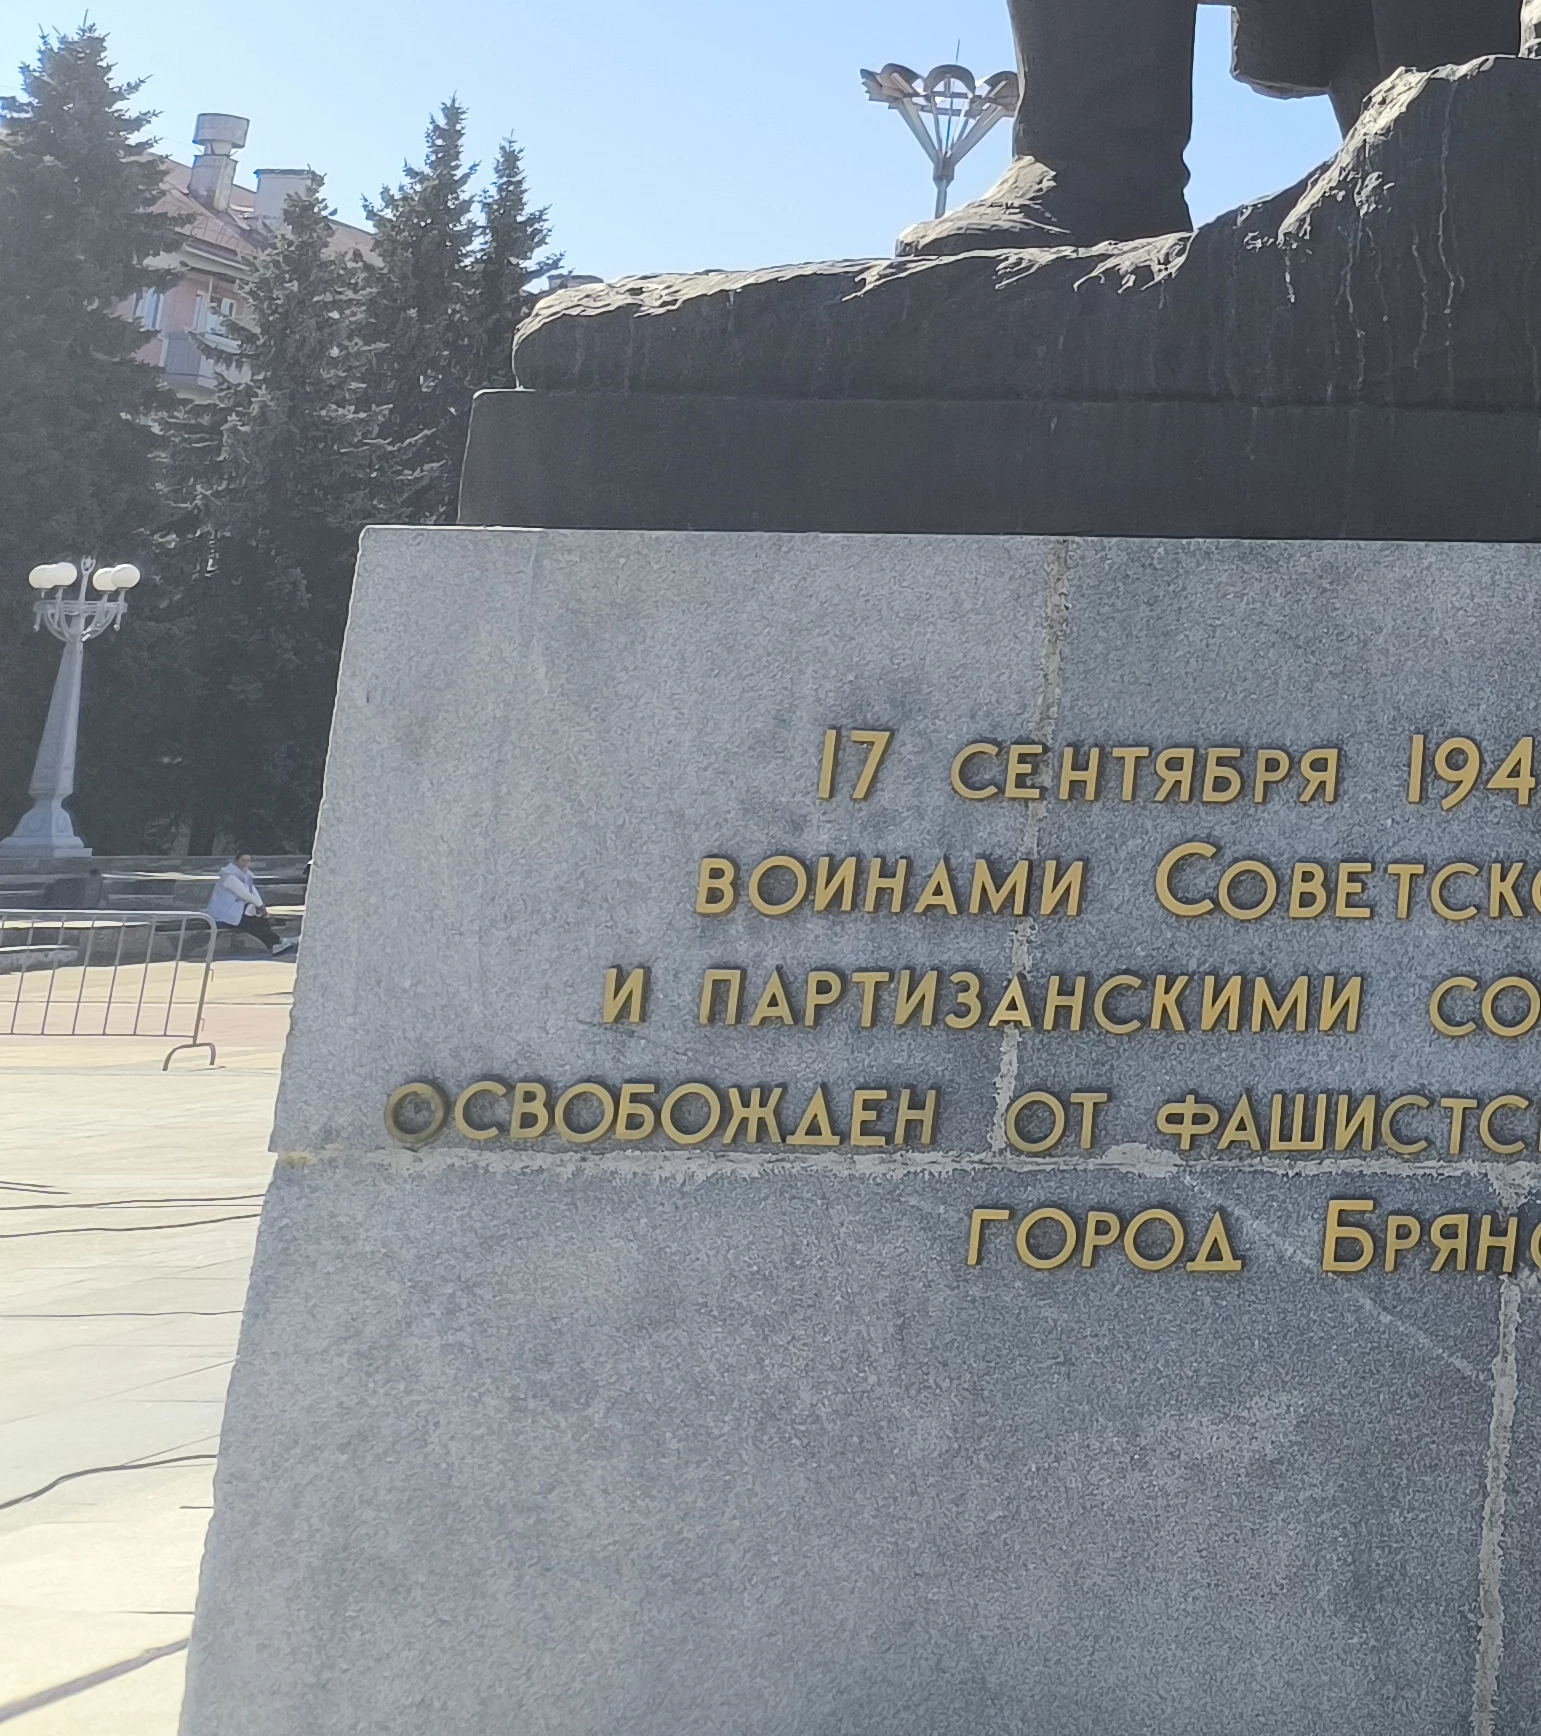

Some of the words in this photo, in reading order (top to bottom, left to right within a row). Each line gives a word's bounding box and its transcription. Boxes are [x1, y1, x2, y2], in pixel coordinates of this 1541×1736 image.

[816, 728, 891, 800] 17
[950, 742, 1338, 803] СЕНТЯБРЯ
[695, 855, 1084, 916] ВОИНАМИ
[602, 967, 645, 1023] И
[699, 968, 1362, 1035] ПАРТИЗАНСКИМИ
[384, 1080, 938, 1146] ОСВОБОЖДЕН
[1005, 1091, 1108, 1153] ОТ
[966, 1207, 1243, 1271] ГОРОД
